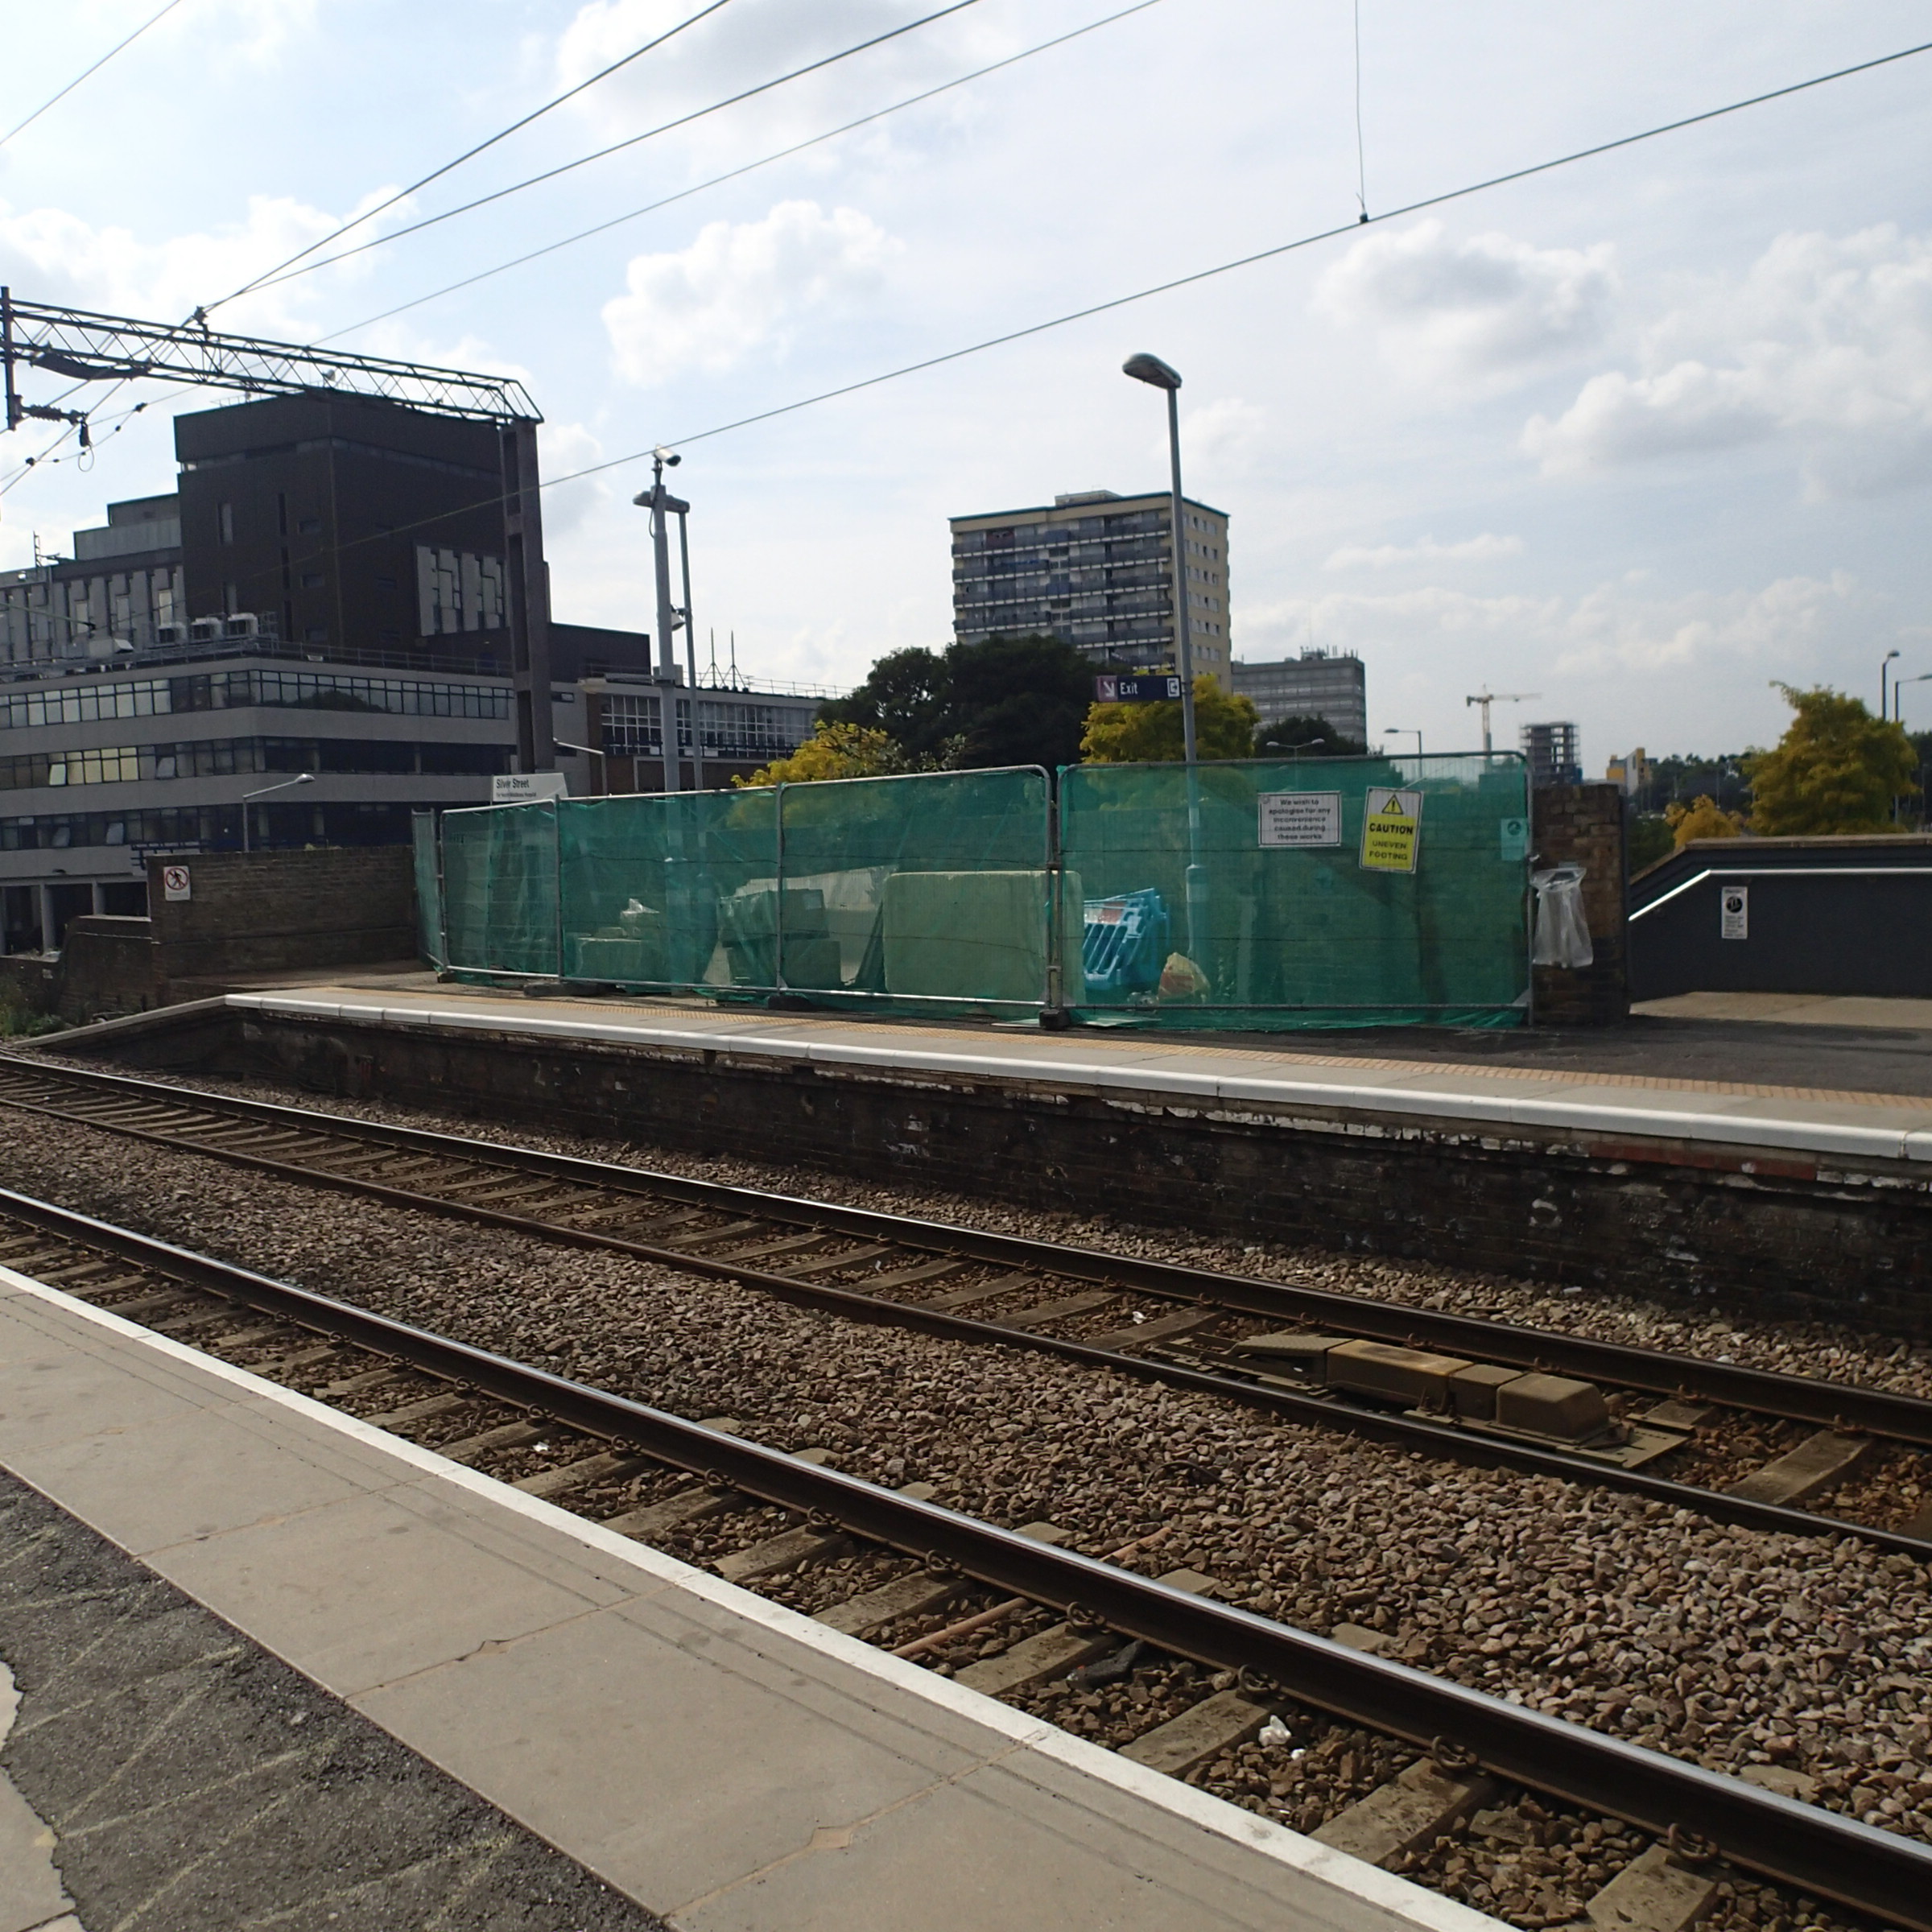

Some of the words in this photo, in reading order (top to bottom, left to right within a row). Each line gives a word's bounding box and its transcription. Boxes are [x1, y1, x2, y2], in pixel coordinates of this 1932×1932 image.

[1120, 682, 1138, 695] Exit
[496, 778, 511, 789] Silver
[512, 778, 530, 789] Street
[1302, 824, 1326, 832] during
[1369, 823, 1414, 835] CAUTION
[1372, 840, 1407, 849] UNEVEN
[1369, 850, 1408, 861] FOOTING
